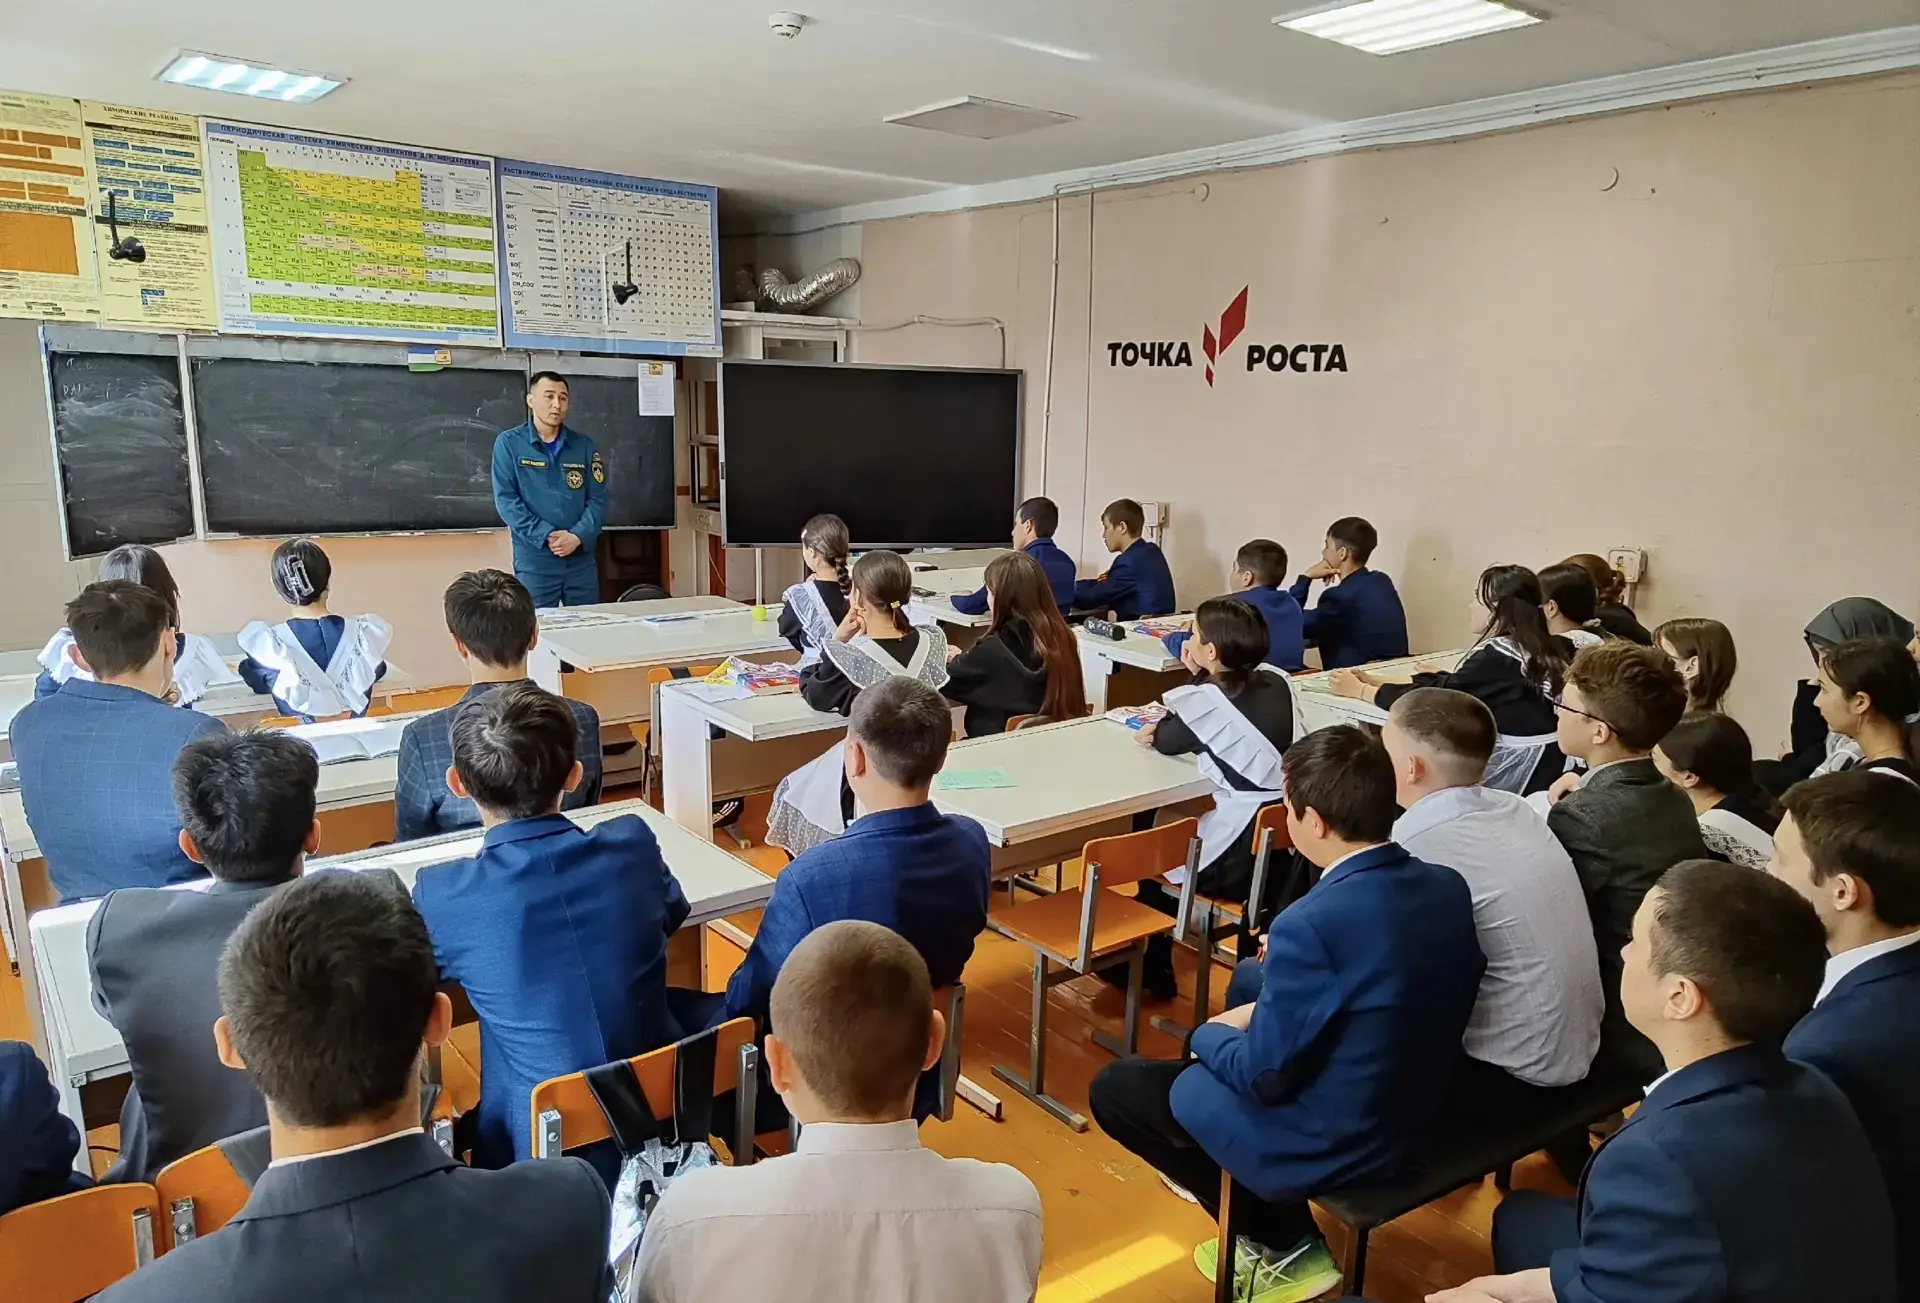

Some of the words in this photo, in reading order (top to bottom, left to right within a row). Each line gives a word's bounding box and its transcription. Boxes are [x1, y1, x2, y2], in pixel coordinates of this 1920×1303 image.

[220, 125, 286, 139] ПЕРИОДИЧЕСКАЯ
[289, 134, 323, 144] СИСТЕМА
[326, 140, 373, 152] ХИМИЧЕСКИХ
[376, 147, 417, 158] ЭЛЕМЕНТОВ
[504, 167, 554, 178] РАСТВОРИМОСТЬ
[1107, 342, 1192, 367] ТОЧКА
[1246, 344, 1348, 372] РОСТА
